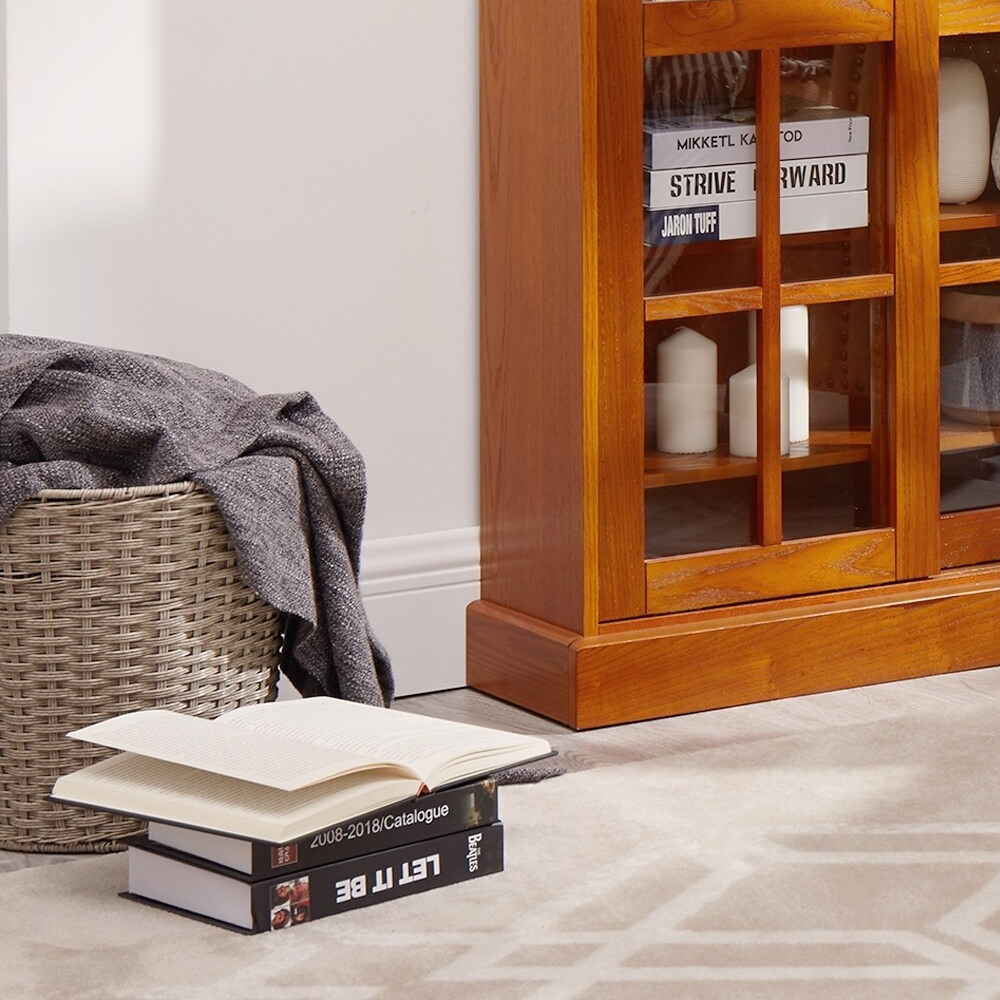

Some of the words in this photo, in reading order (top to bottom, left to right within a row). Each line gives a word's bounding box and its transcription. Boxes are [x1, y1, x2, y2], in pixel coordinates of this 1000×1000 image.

[676, 135, 735, 150] MIKKETL
[670, 170, 736, 198] STRIVE
[661, 213, 693, 238] JARON
[693, 210, 718, 234] TUFF
[310, 804, 450, 849] 2008-2018/Catalogue
[466, 832, 482, 873] BEATLES
[372, 867, 393, 893] IT
[399, 853, 441, 886] LET
[335, 874, 367, 904] BE
